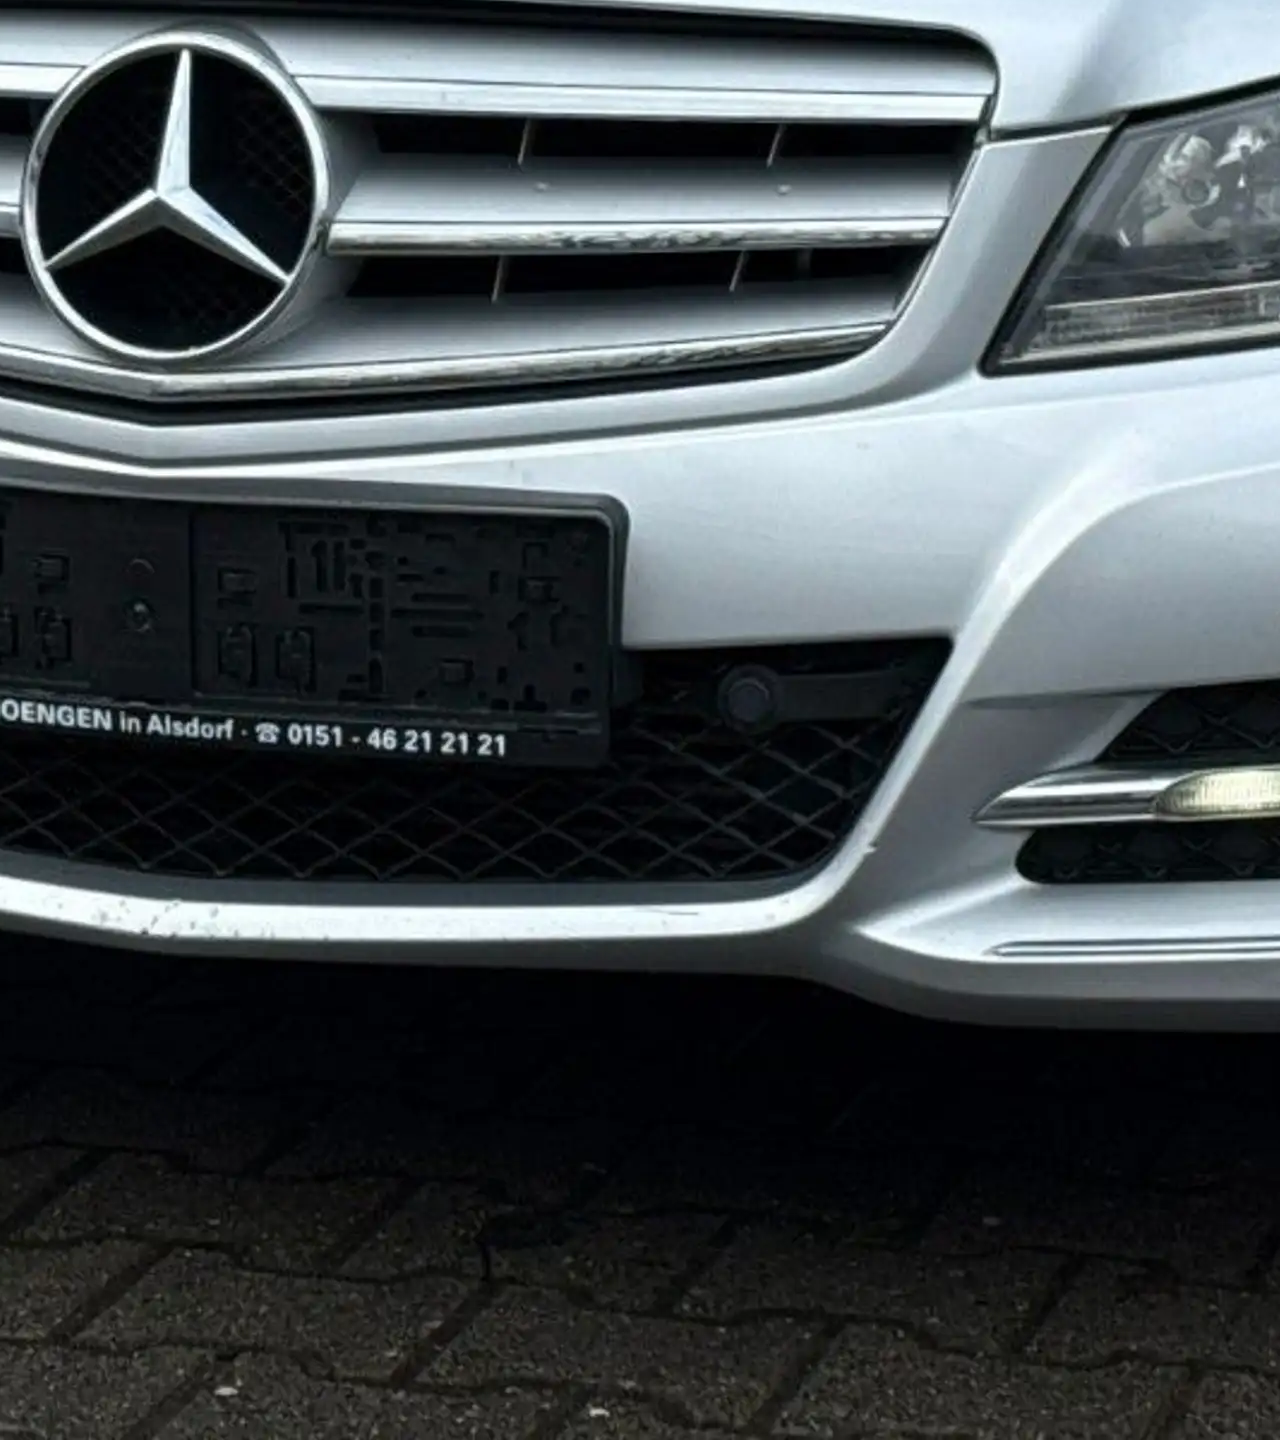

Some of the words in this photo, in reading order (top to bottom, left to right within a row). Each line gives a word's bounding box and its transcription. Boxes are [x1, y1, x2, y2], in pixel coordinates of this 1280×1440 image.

[120, 711, 141, 733] in
[146, 713, 234, 740] Alsdorf
[287, 723, 343, 747] 0151
[367, 728, 397, 750] 46
[404, 729, 432, 752] 21
[440, 731, 469, 754] 21
[477, 733, 506, 756] 21
